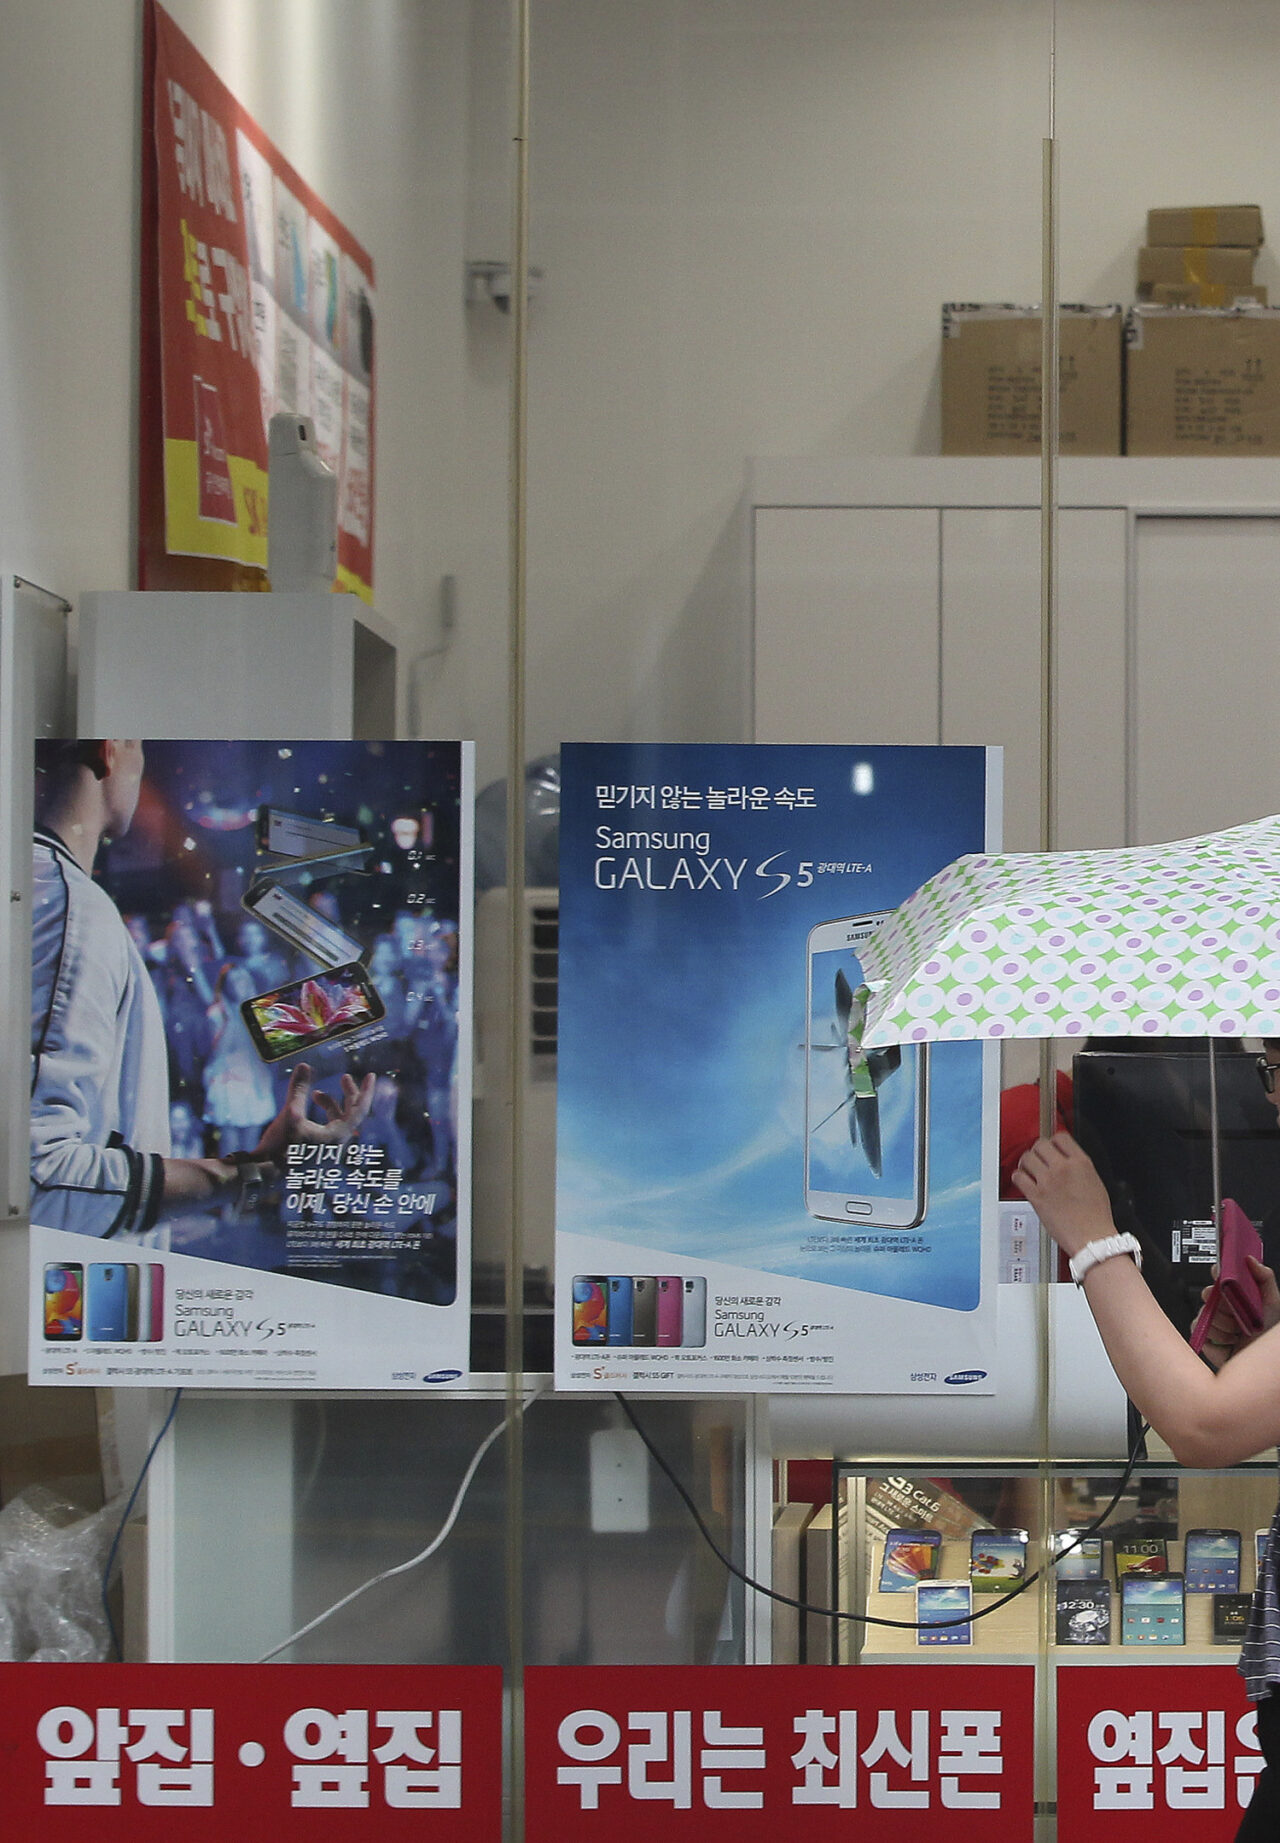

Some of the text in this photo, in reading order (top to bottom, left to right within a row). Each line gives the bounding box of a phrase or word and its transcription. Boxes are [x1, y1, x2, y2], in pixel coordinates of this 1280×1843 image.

[595, 785, 817, 811] 믿기지 않는 놀라운 속도
[595, 825, 711, 856] Samsung
[594, 856, 748, 890] GALAXY
[816, 862, 846, 875] 광대역
[846, 862, 873, 874] LTE-A
[847, 931, 874, 941] SAMSU
[286, 1143, 385, 1166] 믿기지 않는
[285, 1168, 403, 1191] 놀라운 속도를
[286, 1192, 436, 1215] 이제, 당신 손 안에
[175, 1304, 234, 1319] Samsung
[715, 1296, 739, 1306] 당신의
[715, 1309, 765, 1322] Samsung
[174, 1320, 253, 1337] GALAXY
[714, 1323, 781, 1338] GALAXY
[37, 1706, 214, 1807] 앞집
[284, 1707, 461, 1809] 옆집
[557, 1709, 1002, 1810] 우리는 최신폰
